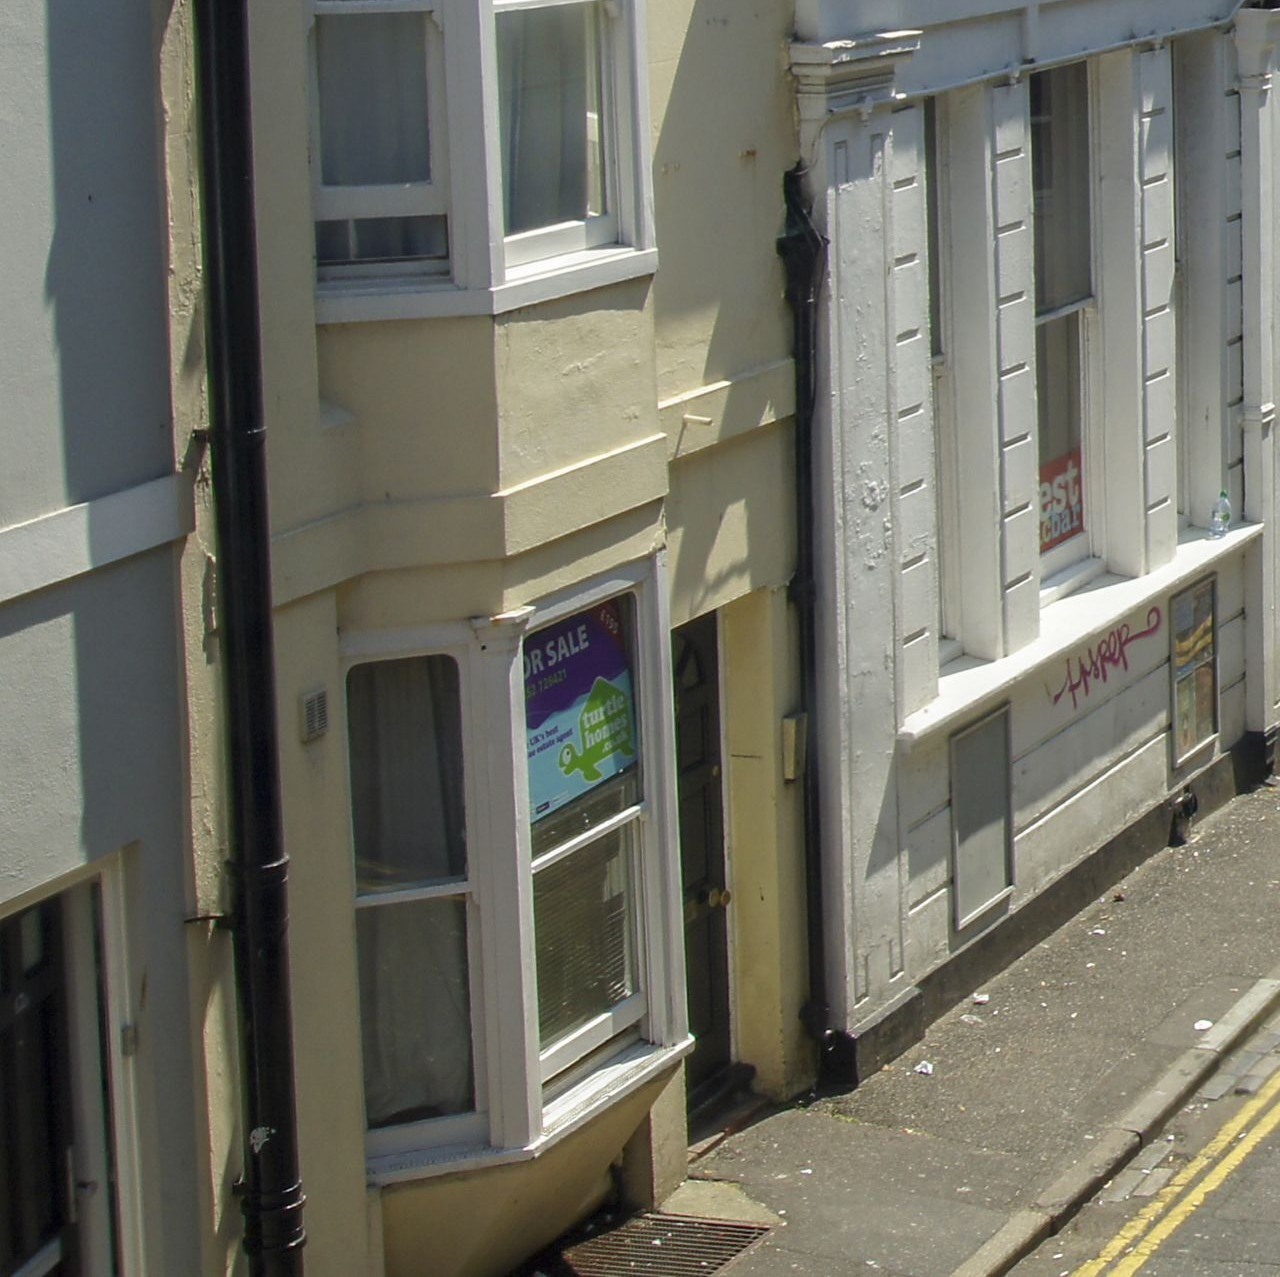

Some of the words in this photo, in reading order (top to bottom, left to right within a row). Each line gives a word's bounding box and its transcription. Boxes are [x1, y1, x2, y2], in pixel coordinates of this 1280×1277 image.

[545, 624, 589, 667] SALE
[582, 694, 625, 729] turtle
[584, 713, 628, 749] homes
